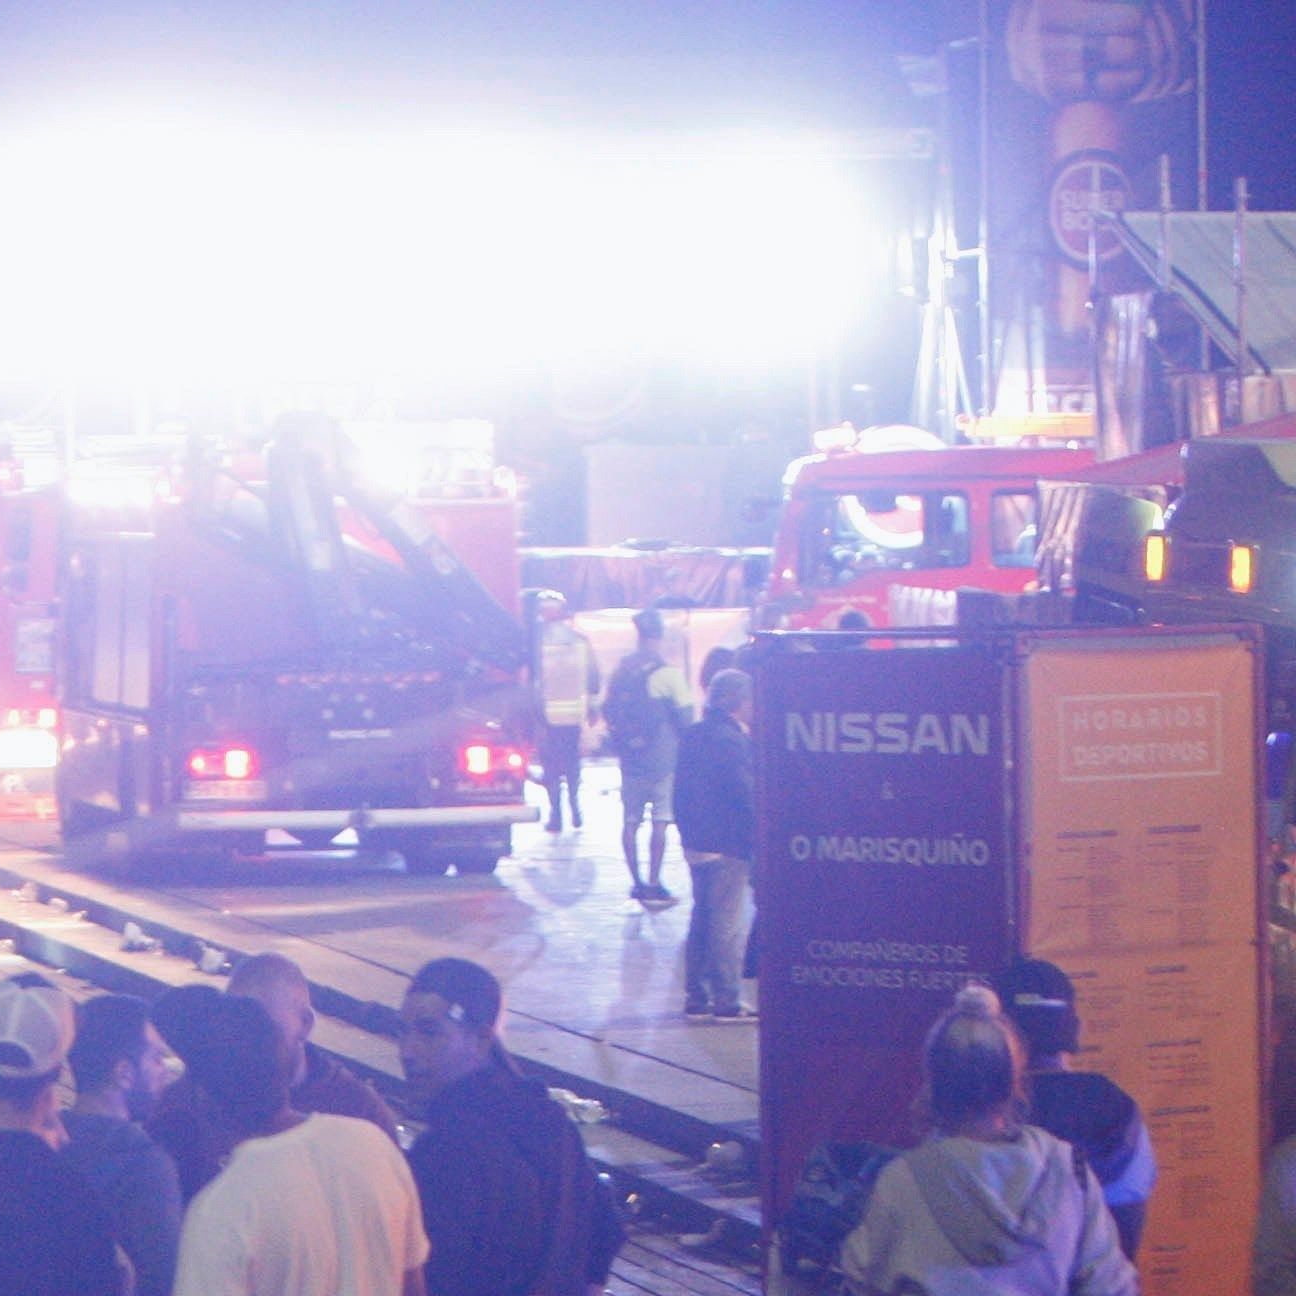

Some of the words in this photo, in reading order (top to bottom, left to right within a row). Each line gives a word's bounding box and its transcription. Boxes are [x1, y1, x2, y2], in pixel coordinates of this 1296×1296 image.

[1071, 704, 1207, 731] HORARIOS
[785, 712, 989, 755] NISSAN
[1071, 740, 1209, 767] DEPORTIVOS
[790, 834, 810, 861] O
[816, 833, 990, 867] MARISQUIÑO
[807, 939, 940, 964] COMPAÑEROS
[943, 944, 970, 965] DE
